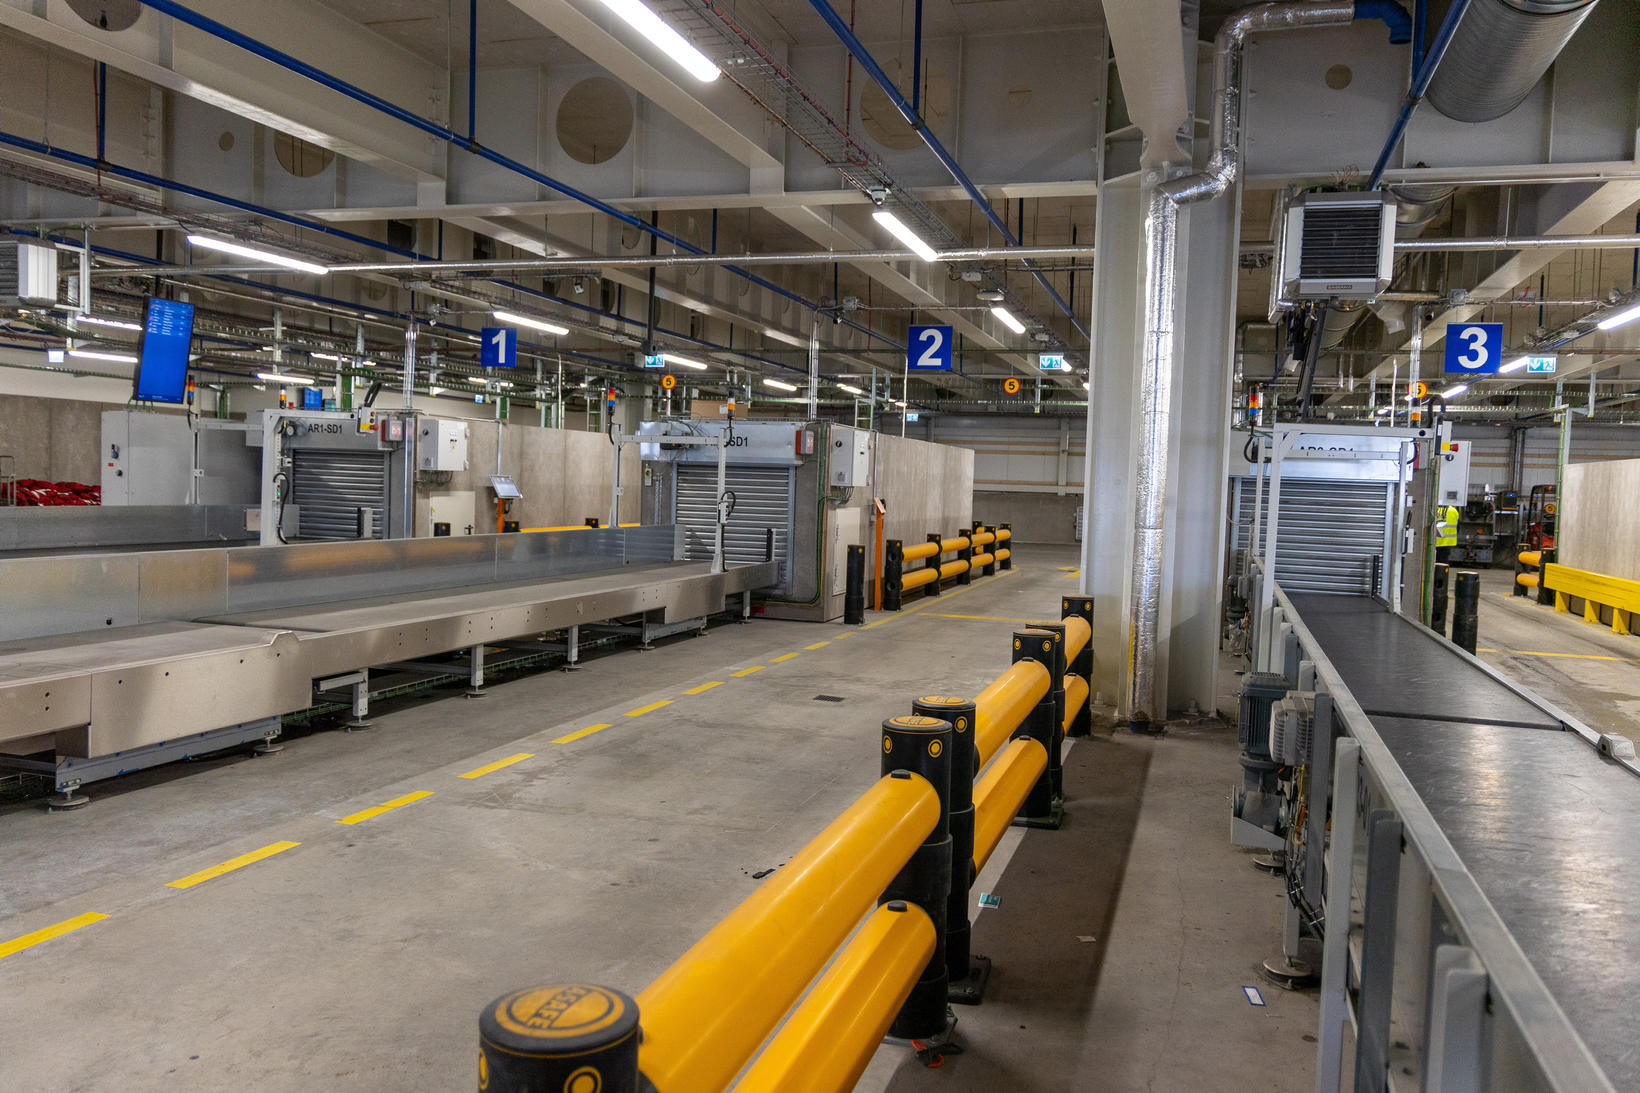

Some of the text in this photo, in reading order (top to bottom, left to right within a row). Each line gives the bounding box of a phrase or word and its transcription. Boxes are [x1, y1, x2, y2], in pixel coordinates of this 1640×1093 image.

[492, 329, 506, 364] 1
[917, 328, 943, 366] 2
[1458, 327, 1488, 369] 3
[666, 378, 672, 386] 5
[1008, 381, 1016, 391] 5
[307, 424, 343, 434] AR1-SD1
